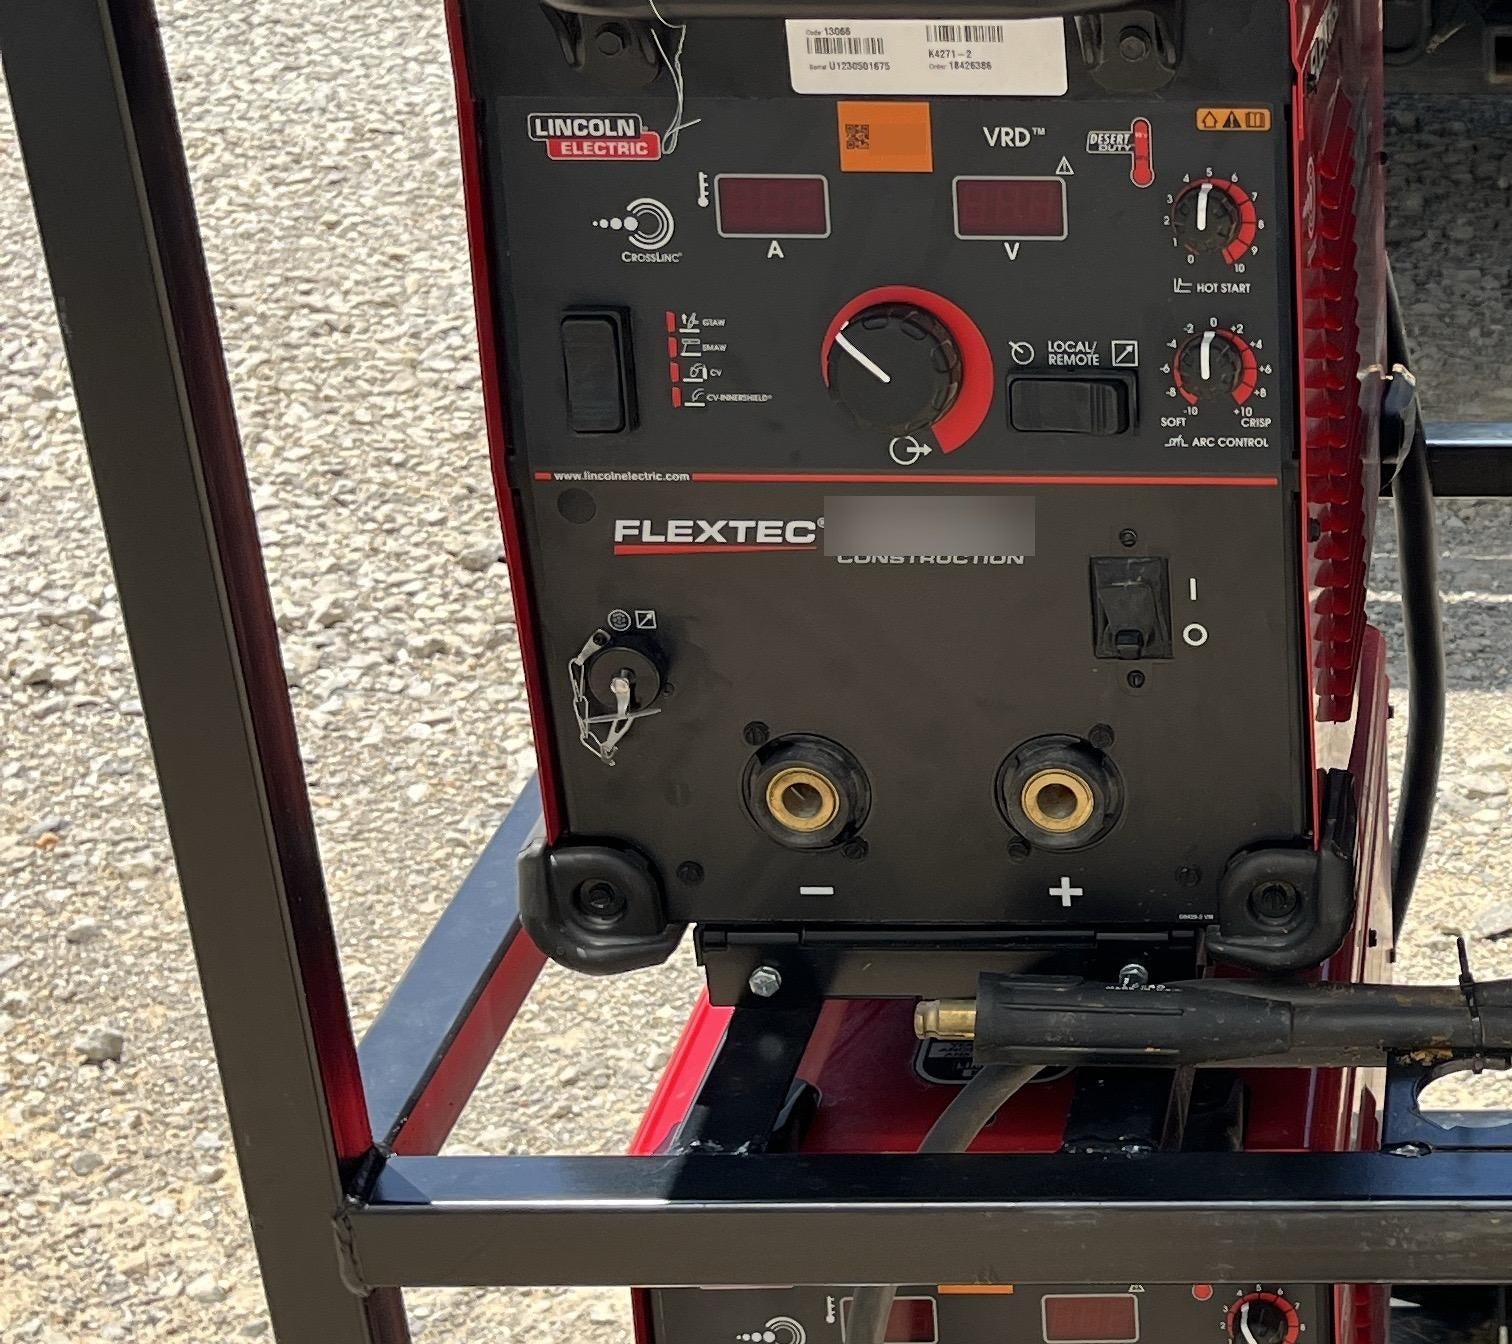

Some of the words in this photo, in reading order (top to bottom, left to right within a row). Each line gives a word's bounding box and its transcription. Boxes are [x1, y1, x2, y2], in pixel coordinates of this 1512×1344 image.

[536, 119, 635, 136] LINCOLN
[1090, 133, 1130, 144] DESERT
[560, 142, 648, 155] ELECTRIC
[1207, 168, 1212, 177] 5
[1183, 174, 1189, 182] 4
[1232, 173, 1238, 182] 6
[1167, 194, 1173, 203] 3
[1252, 192, 1257, 201] 7
[1164, 216, 1169, 225] 2
[1258, 220, 1264, 229] 8
[1173, 238, 1177, 246] 1
[768, 241, 784, 258] A
[1004, 242, 1019, 260] V
[1252, 246, 1257, 255] 9
[1188, 255, 1194, 264] 0
[1235, 264, 1245, 272] 10
[1197, 283, 1218, 293] HOT
[1221, 283, 1250, 293] START
[1048, 340, 1099, 354] LOCAL/
[1049, 354, 1099, 365] REMOTE
[1161, 417, 1186, 427] SOFT
[1241, 418, 1271, 427] CRISP
[1192, 438, 1215, 447] ARC
[1218, 438, 1268, 447] CONTROL
[554, 471, 690, 482] www.lincolnelectric.com
[615, 520, 815, 543] FLEXTEC
